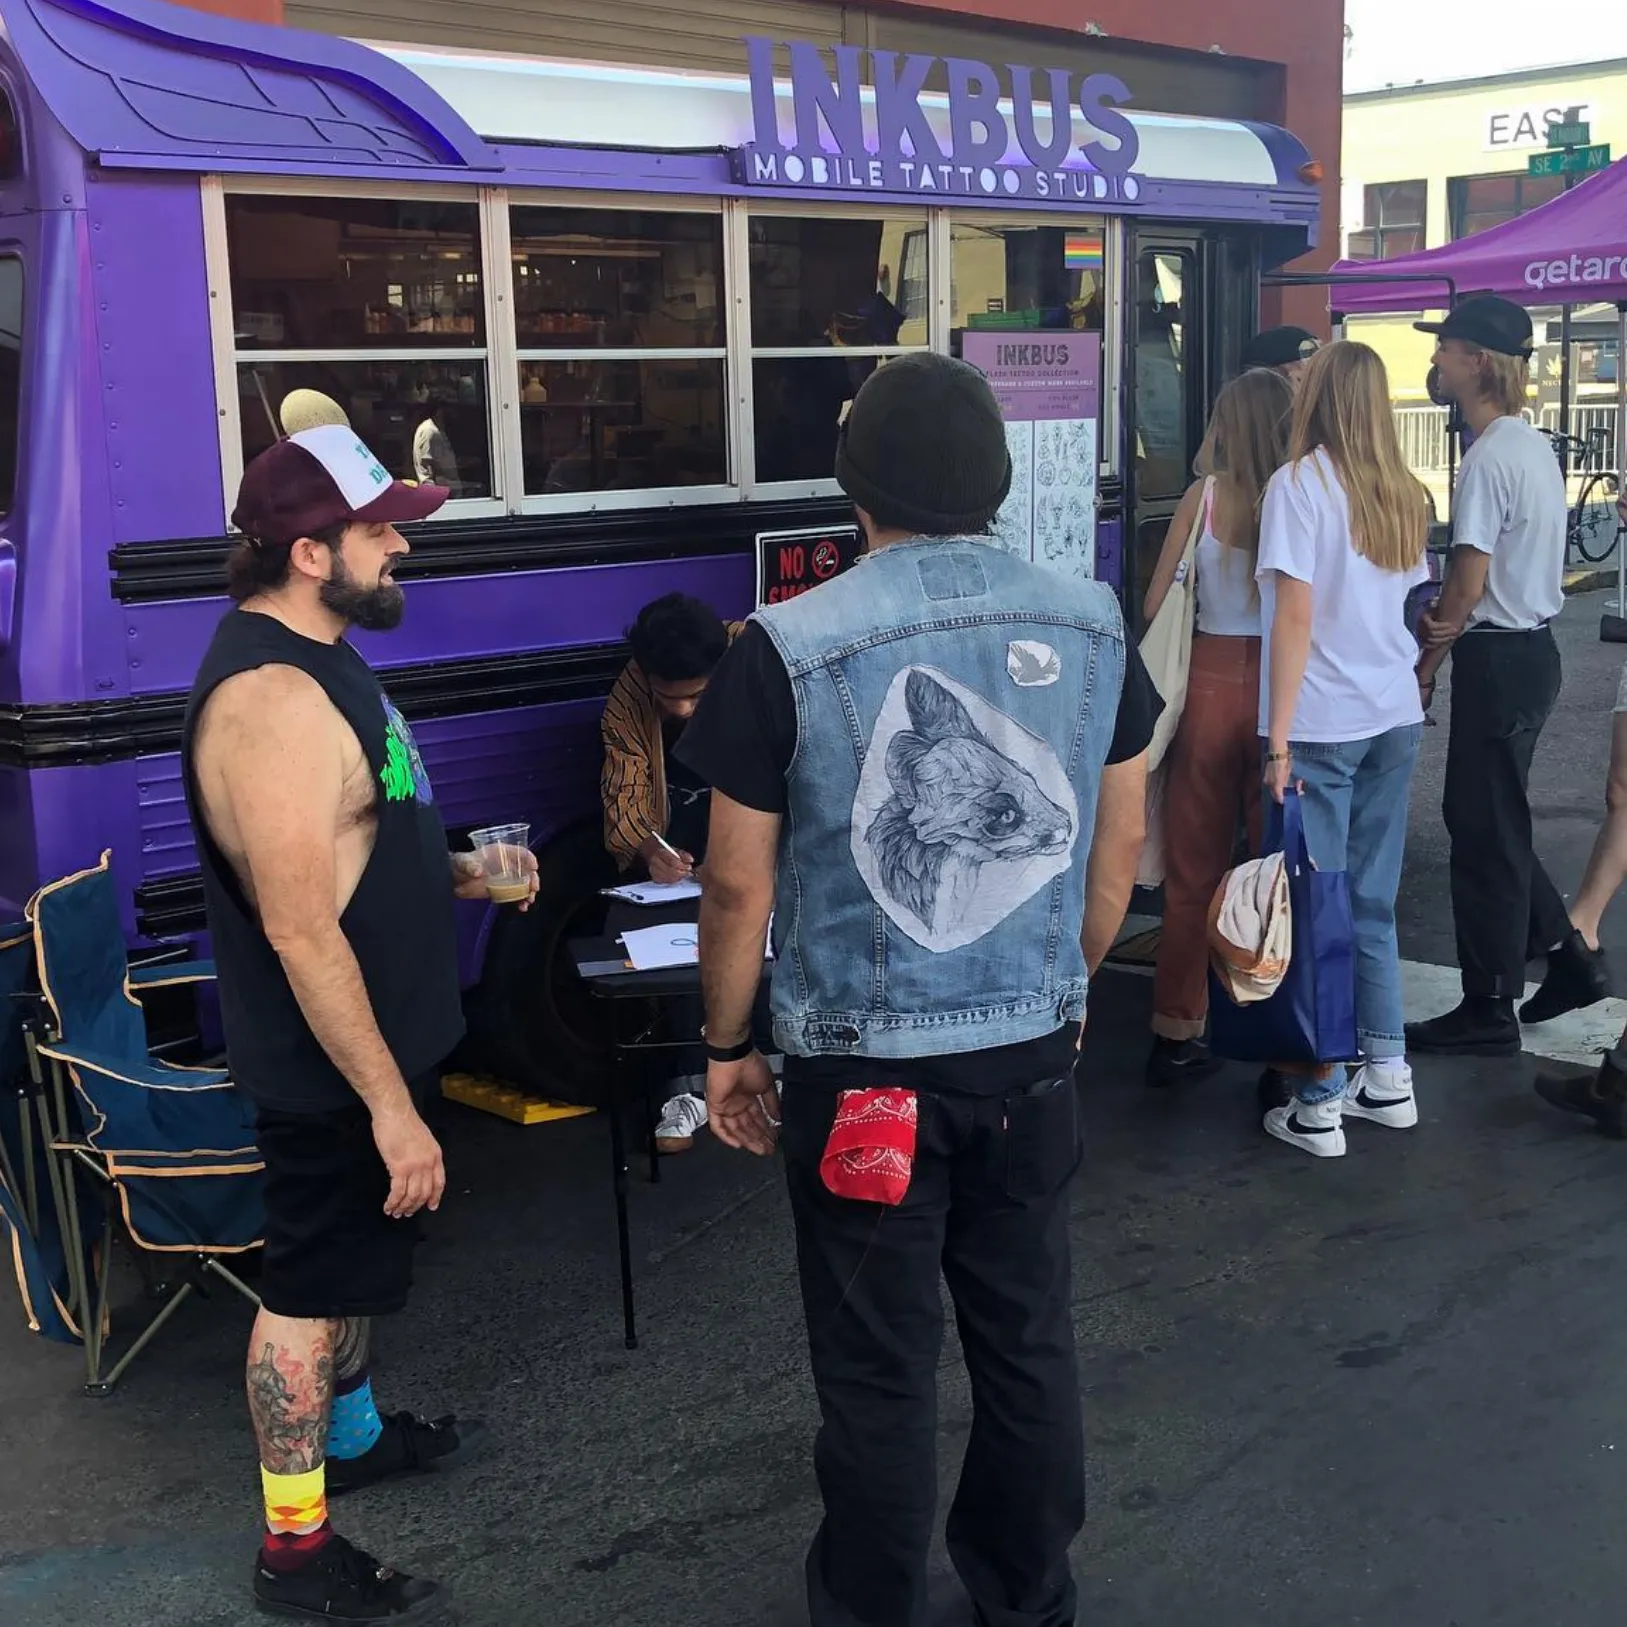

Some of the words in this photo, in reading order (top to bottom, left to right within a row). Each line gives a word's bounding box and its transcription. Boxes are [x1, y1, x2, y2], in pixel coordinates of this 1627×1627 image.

[744, 36, 1140, 173] INKBUS
[754, 152, 884, 187] MOBILE
[900, 161, 1021, 194] TATTOO
[1037, 170, 1140, 201] STUDIO
[1535, 156, 1552, 173] SE
[1587, 149, 1603, 168] AV
[996, 344, 1069, 366] INKBUS
[779, 545, 804, 581] NO
